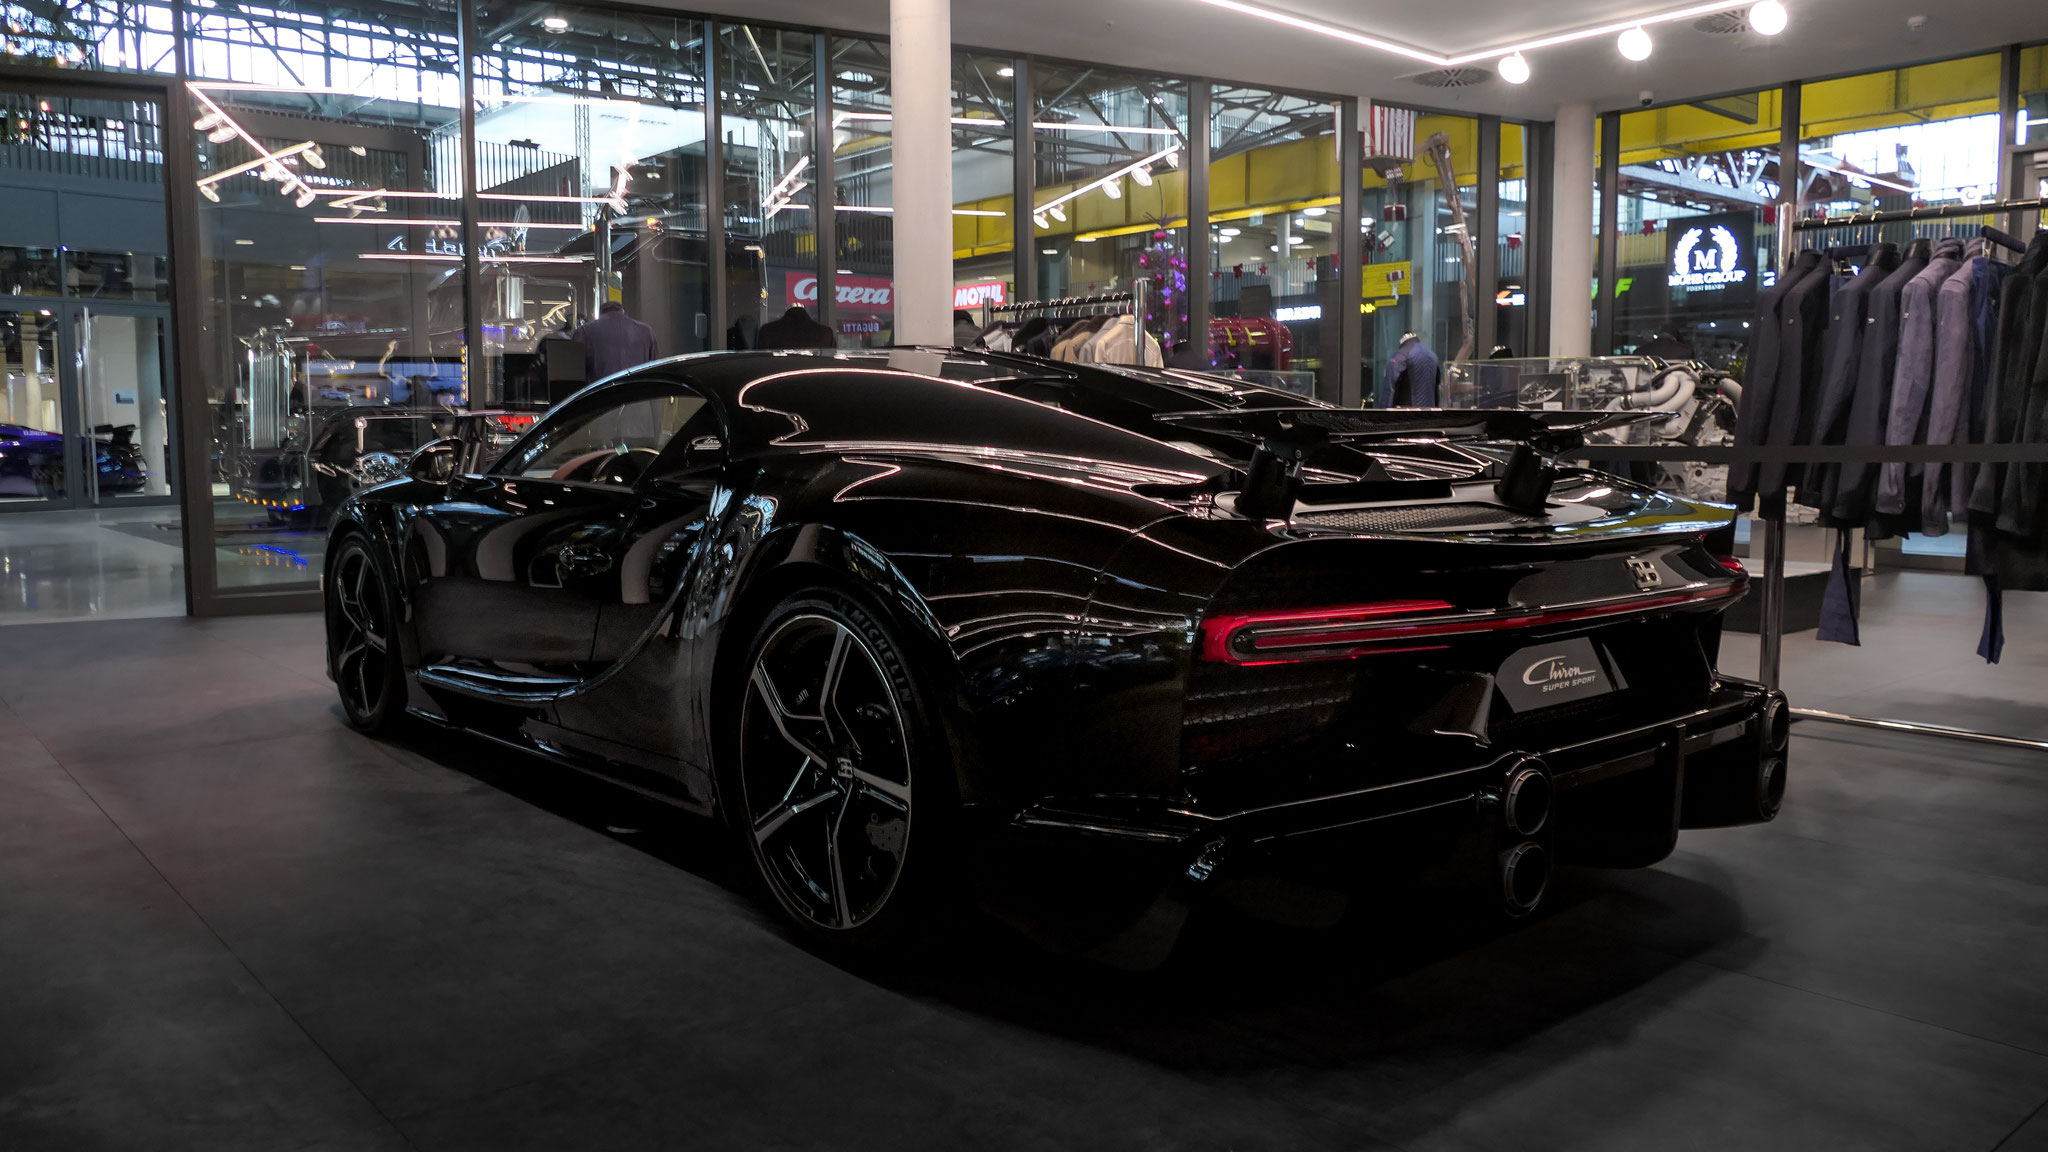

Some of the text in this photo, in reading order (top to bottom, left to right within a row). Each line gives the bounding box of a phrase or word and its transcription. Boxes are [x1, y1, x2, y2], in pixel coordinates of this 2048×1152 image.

[1693, 248, 1718, 270] M
[1668, 272, 1704, 286] MOHR
[1704, 269, 1746, 284] GROUP
[794, 278, 890, 304] Crera
[954, 284, 1003, 307] MOTUL
[850, 608, 913, 703] MICHELIN
[1522, 655, 1597, 685] Chiron
[1542, 675, 1597, 693] SUPER SPORT
